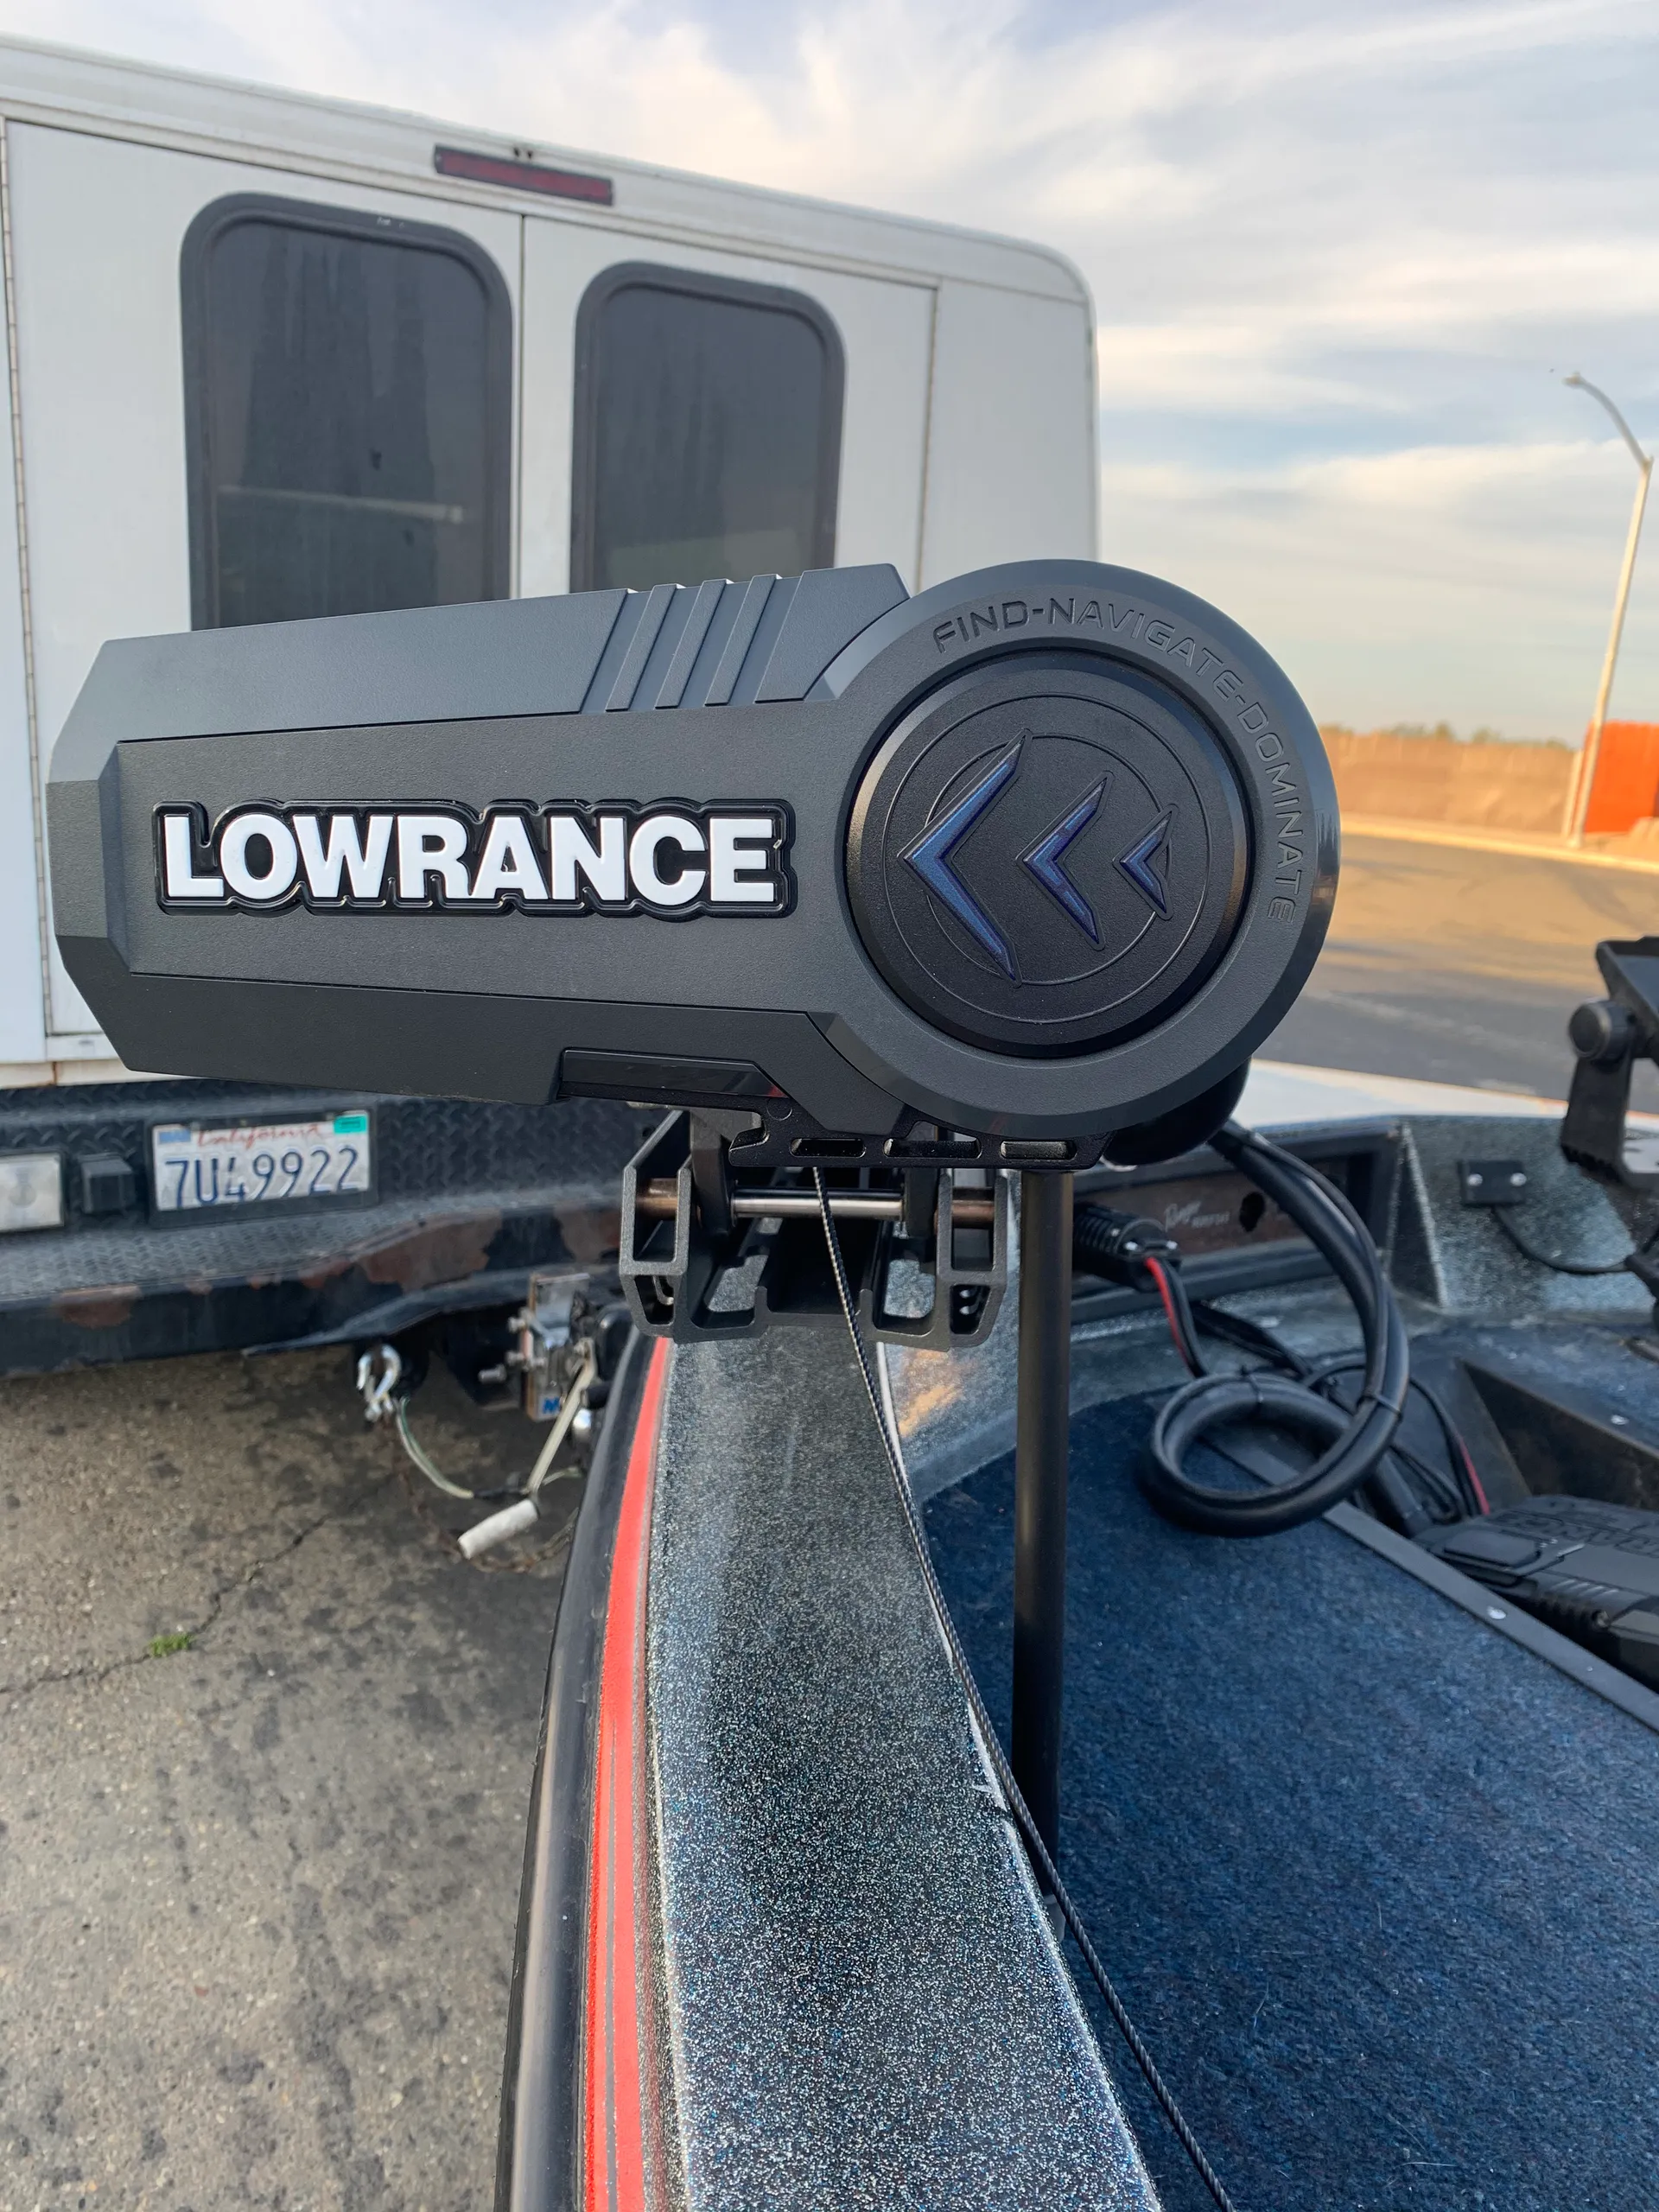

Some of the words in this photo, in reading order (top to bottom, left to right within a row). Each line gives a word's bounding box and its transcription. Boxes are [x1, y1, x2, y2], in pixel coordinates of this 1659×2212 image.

[932, 597, 1304, 924] FIND-NAVIGATE-DOMINATE
[164, 812, 778, 906] LOWRANCE
[164, 1144, 359, 1208] 7U49922
